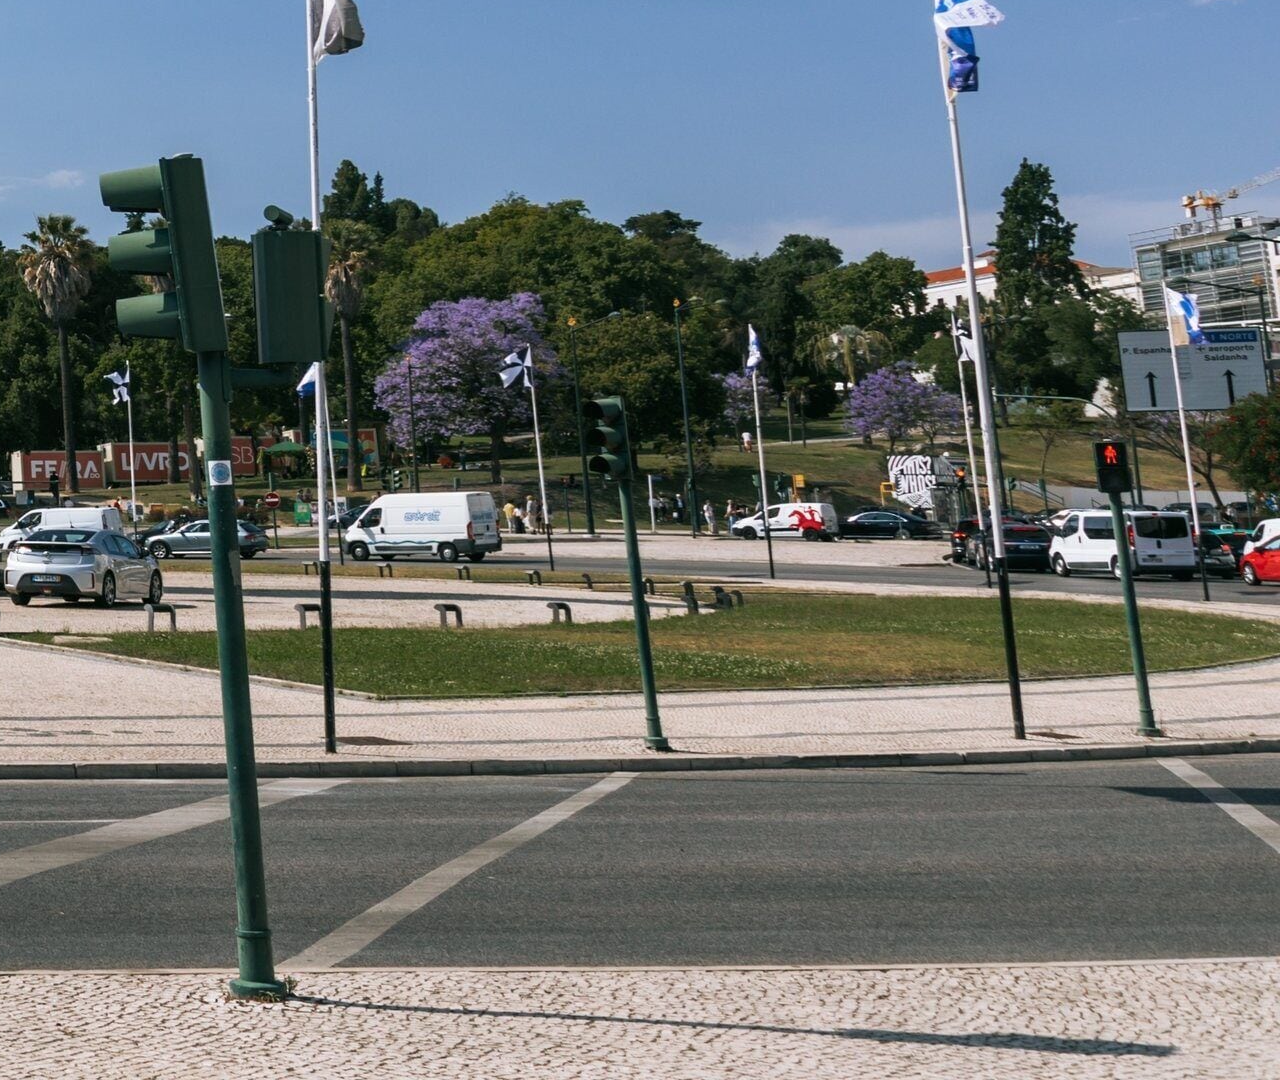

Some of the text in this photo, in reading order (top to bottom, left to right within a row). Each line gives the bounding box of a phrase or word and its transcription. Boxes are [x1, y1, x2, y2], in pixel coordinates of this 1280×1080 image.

[1219, 332, 1254, 341] NORTE
[1133, 346, 1172, 356] Espanha
[1208, 344, 1255, 353] aeroporto
[1204, 353, 1248, 362] Saldanha
